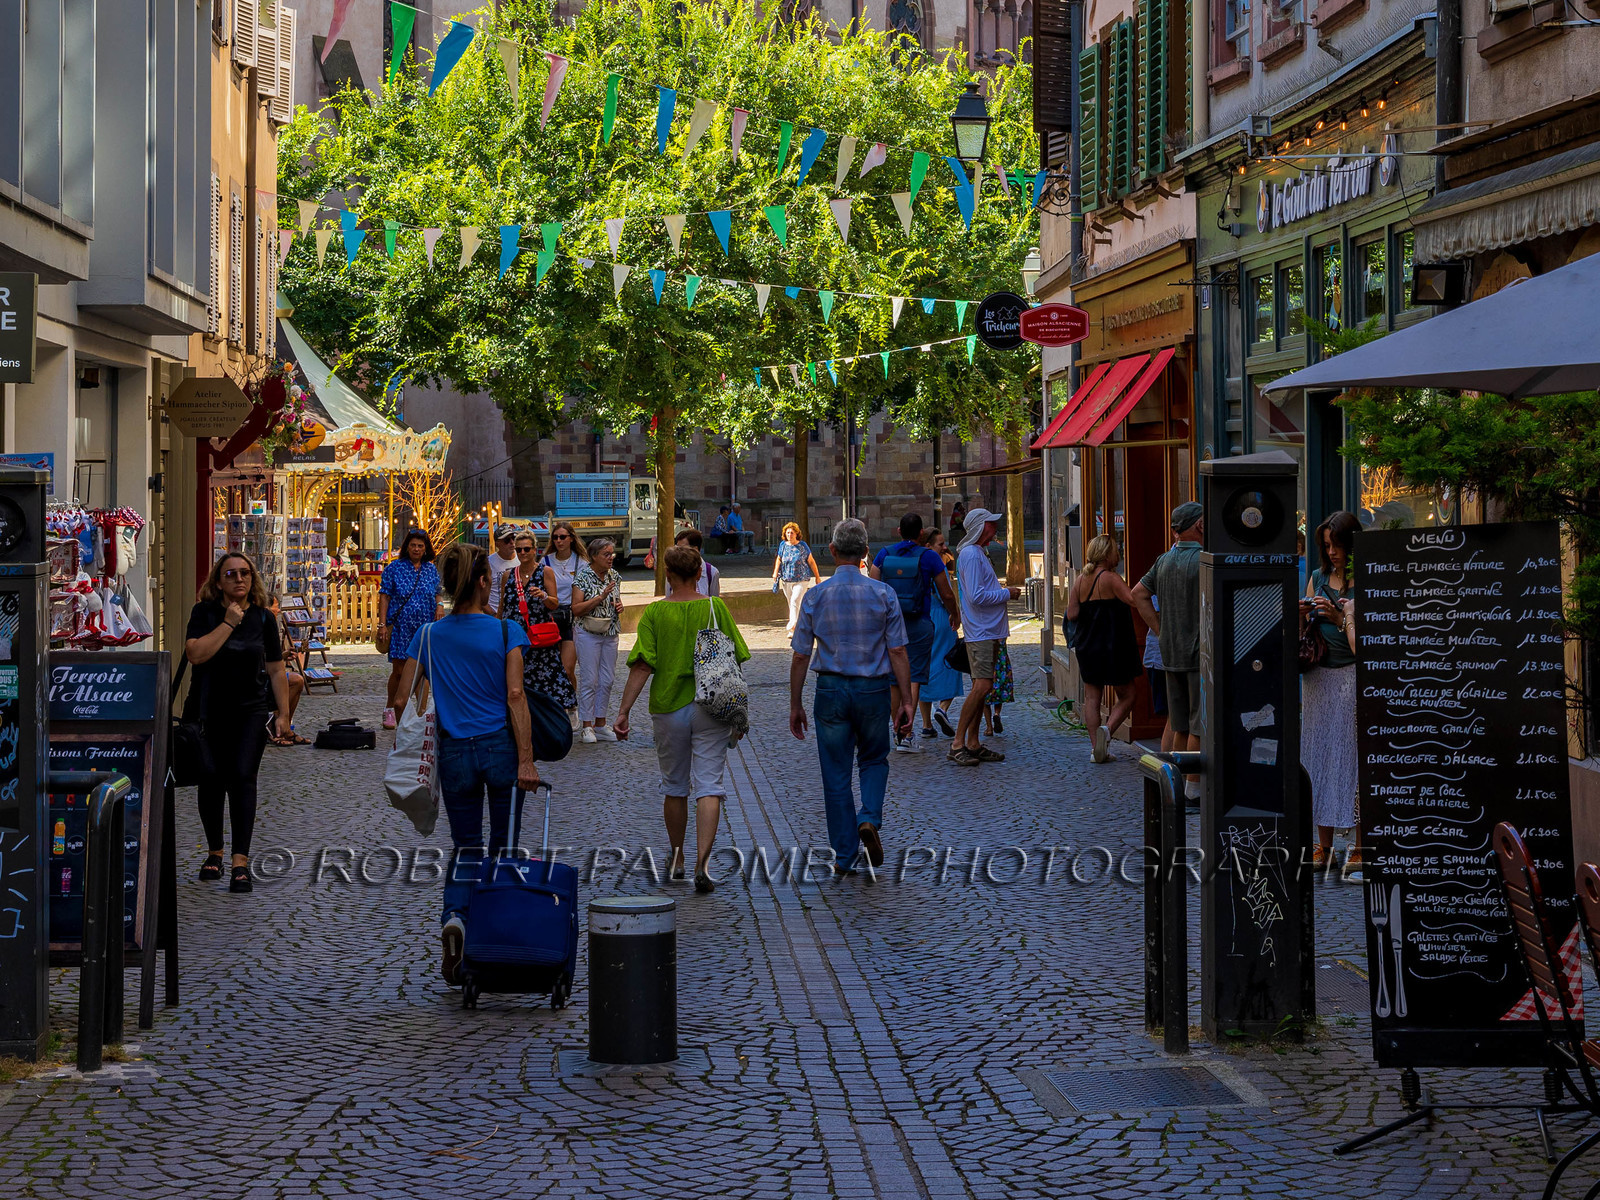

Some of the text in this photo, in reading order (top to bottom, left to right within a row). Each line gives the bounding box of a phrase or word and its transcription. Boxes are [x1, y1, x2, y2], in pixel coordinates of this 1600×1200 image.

[1327, 145, 1375, 208] Terroir
[983, 308, 995, 319] Les
[194, 390, 222, 399] Atelier
[168, 400, 248, 410] Hammaecher Sipion
[1411, 529, 1455, 545] MENU
[1406, 557, 1461, 574] FLAMBÉE
[1463, 550, 1504, 571] NATURE
[1364, 587, 1400, 599] TARTE
[1403, 584, 1455, 597] FLAMBÉE
[1363, 611, 1397, 622] TARTE
[1445, 605, 1512, 622] CHAMPIGNONS
[1360, 634, 1396, 646] TARTE
[1398, 632, 1446, 646] FLAMBÉE
[1448, 628, 1502, 646] MUNSTER
[1363, 660, 1399, 671] TARTE
[1399, 657, 1452, 671] FLAMBÉE
[1455, 658, 1507, 671] SAUMON
[52, 665, 127, 684] Terroir
[1363, 683, 1413, 699] CORDON
[1409, 688, 1439, 699] BLEU
[1440, 688, 1454, 699] DE
[1456, 680, 1507, 700] VOLAILLE
[1387, 698, 1418, 707] SAUCE
[1367, 724, 1438, 736] CHOUCROUTE
[1441, 717, 1486, 736] GARNIE
[85, 746, 140, 760] Fraîches
[1367, 753, 1438, 765] BAECKEOFFE
[1370, 784, 1416, 796] JARRET
[1419, 786, 1435, 797] DE
[1438, 784, 1466, 797] PORC
[1385, 797, 1415, 806] SAUCE
[1367, 825, 1419, 837] SALADE
[1422, 823, 1468, 838] CÉSAR
[1371, 855, 1420, 867] SALADE
[1423, 856, 1438, 867] DE
[1442, 850, 1495, 866] SAUMON
[1382, 867, 1404, 875] SUR
[1441, 868, 1456, 876] DE
[1405, 892, 1449, 905] SALADE
[1449, 896, 1463, 906] DE
[1457, 908, 1489, 917] SALADE
[1407, 931, 1450, 943] GALETTES
[1420, 952, 1457, 964] SALADE
